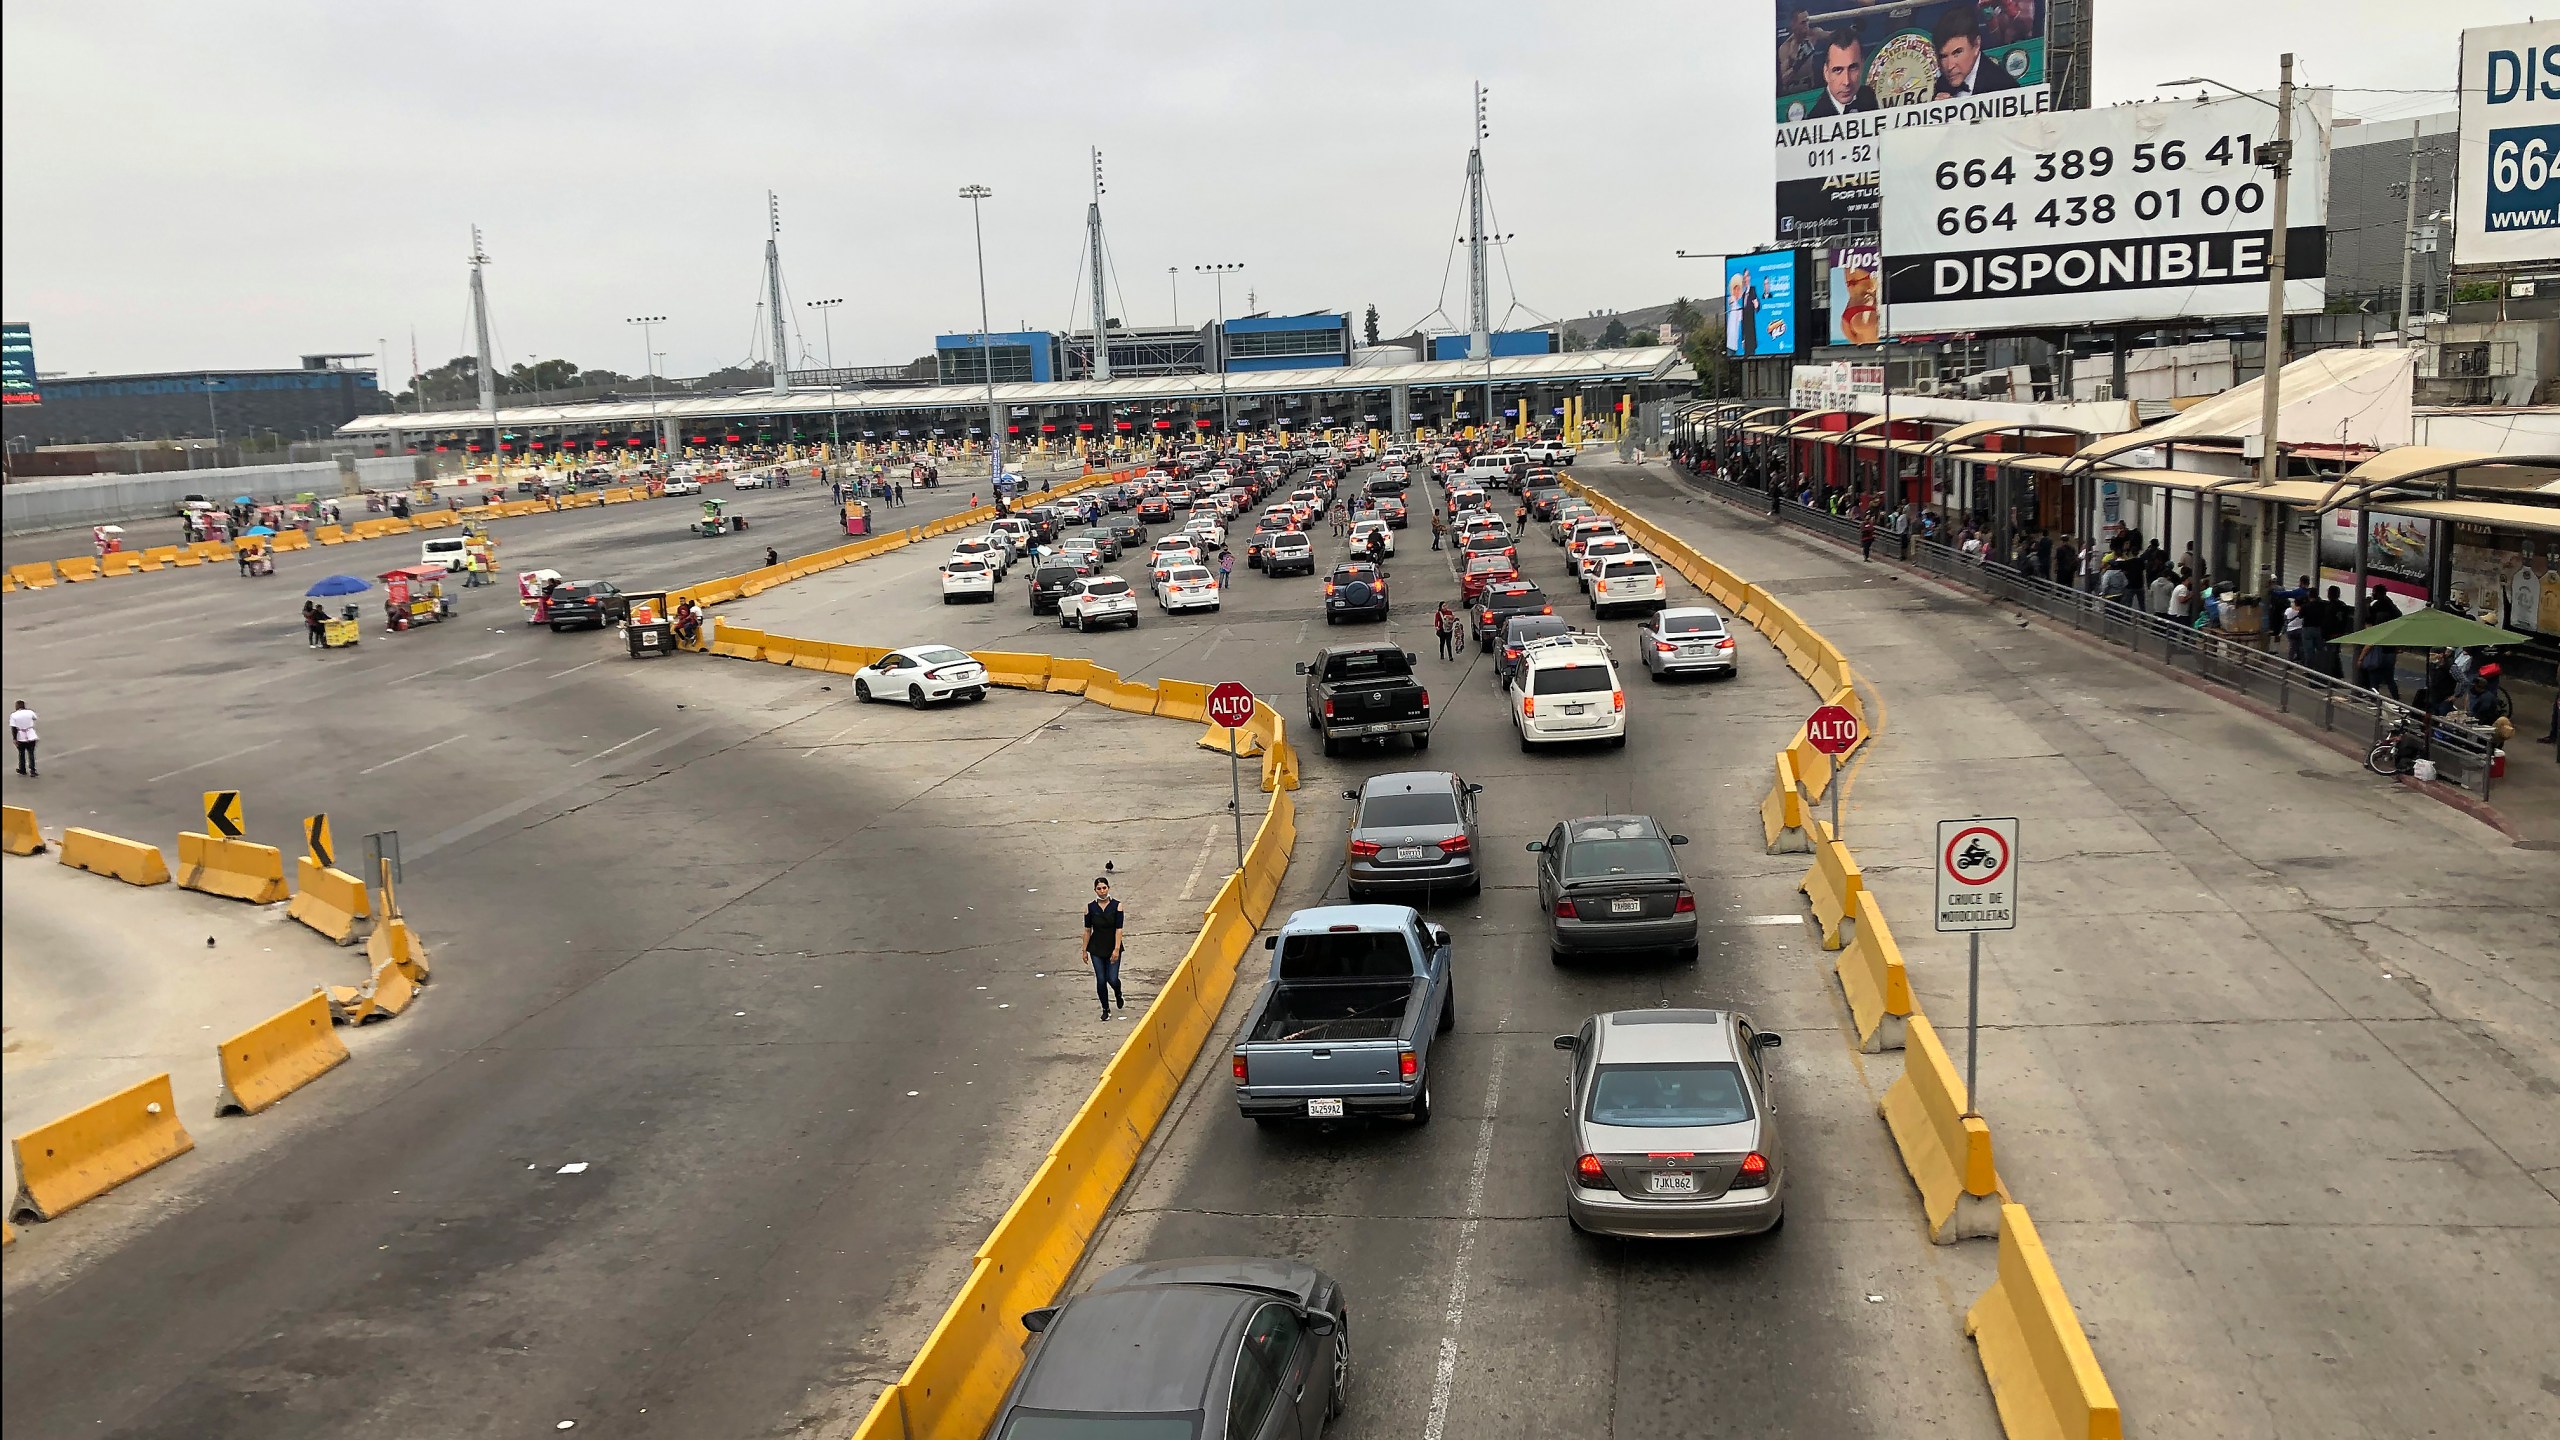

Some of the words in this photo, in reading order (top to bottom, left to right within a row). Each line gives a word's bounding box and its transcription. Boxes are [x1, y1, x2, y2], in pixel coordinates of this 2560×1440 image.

[2487, 44, 2560, 105] DIS
[1882, 87, 1928, 109] WBC
[1775, 115, 1887, 148] AVAILABLE
[1906, 90, 2049, 127] DISPONIBLE
[1808, 148, 1834, 168] 011
[1852, 144, 1871, 163] 52
[1935, 156, 2016, 191] 664
[2033, 146, 2114, 182] 389
[2132, 139, 2187, 173] 56
[2205, 133, 2252, 167] 41
[1937, 202, 2017, 236] 664
[2034, 194, 2116, 228] 438
[2134, 188, 2181, 221] 01
[2201, 182, 2264, 216] 00
[1933, 237, 2265, 296] DISPONIBLE
[1211, 695, 1251, 715] ALTO
[1809, 720, 1857, 740] ALTO
[1948, 893, 1983, 905] CRUCE
[1989, 892, 2003, 904] DE
[1940, 909, 2010, 922] MOTOCICLETAS
[1654, 1177, 1691, 1189] 7JKL862
